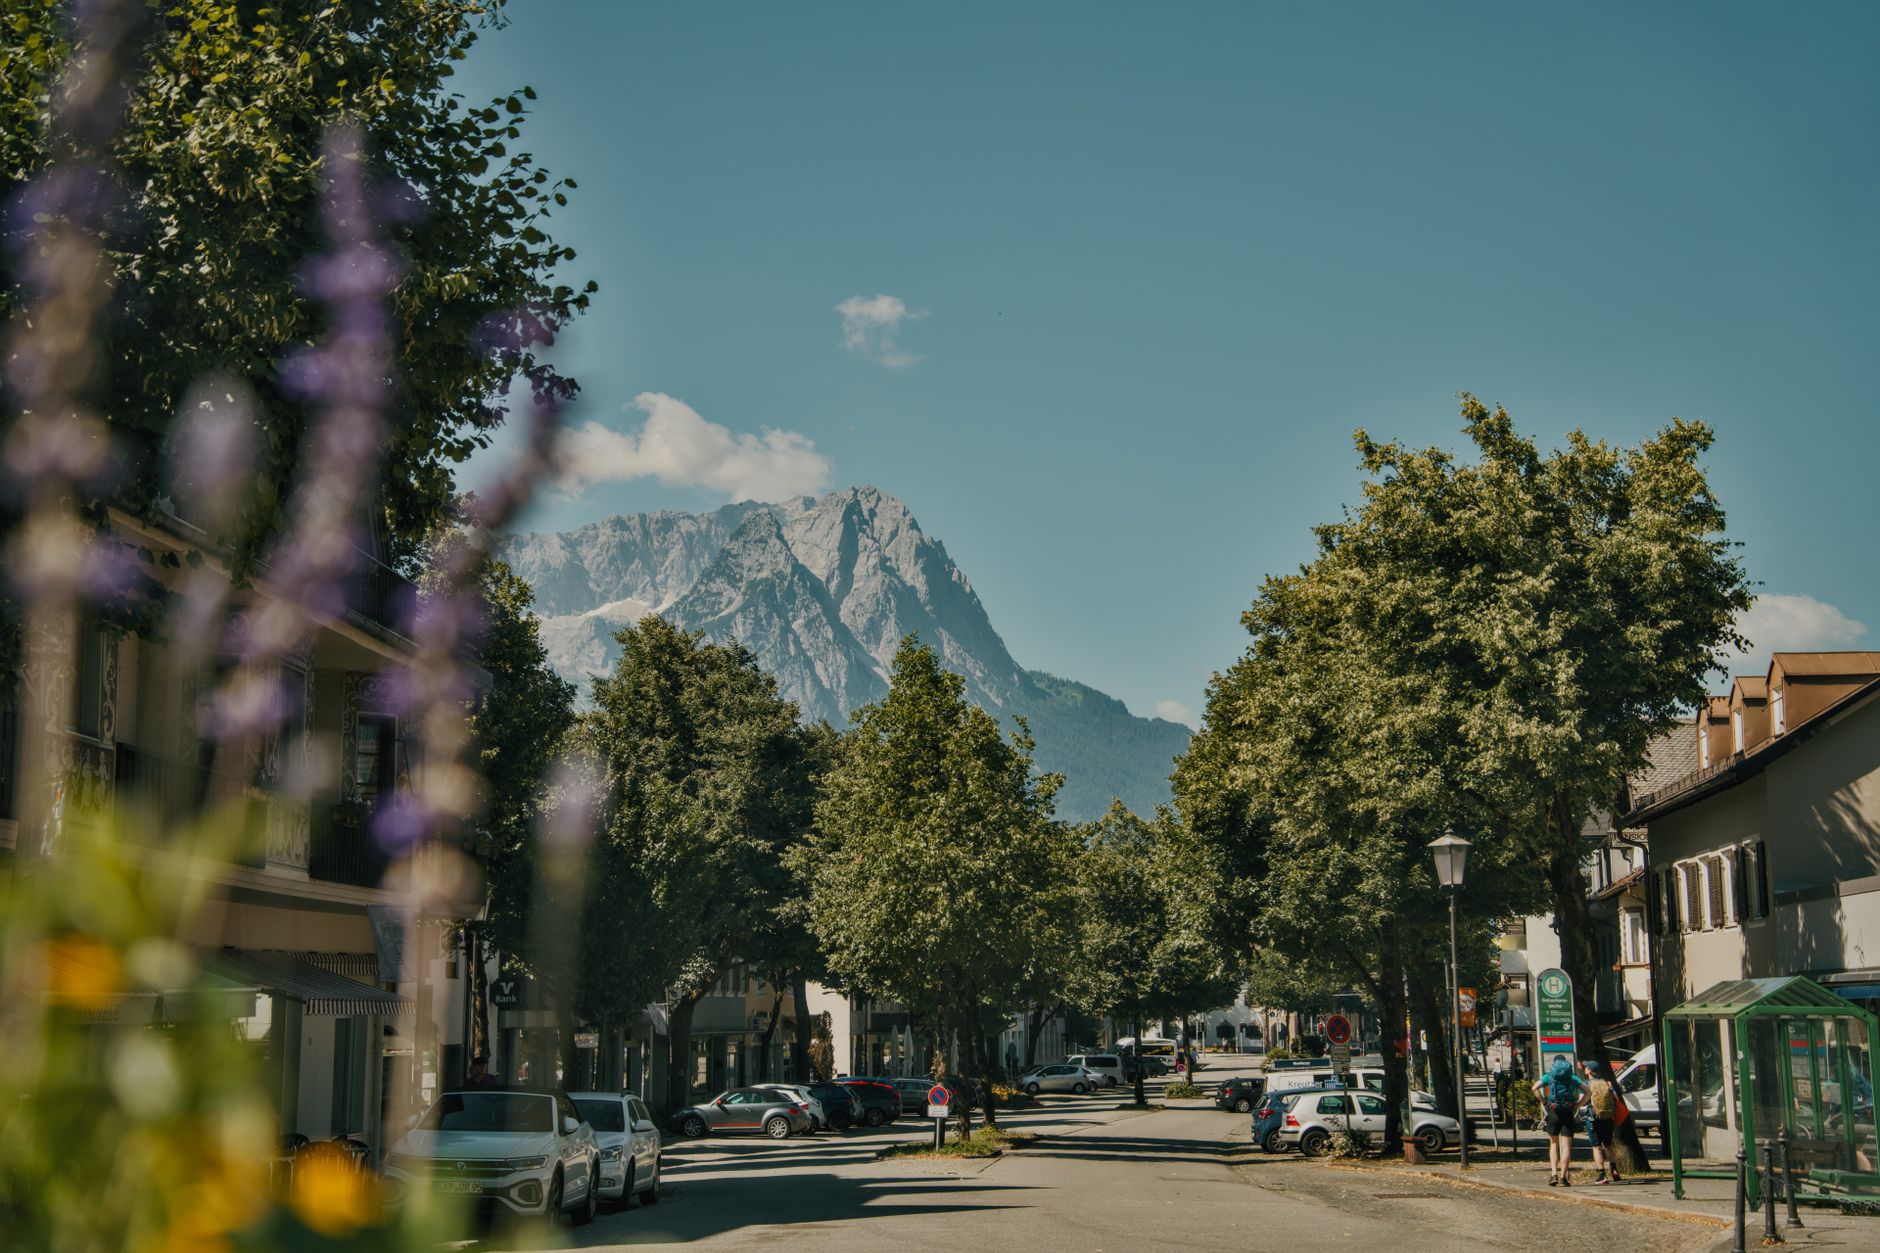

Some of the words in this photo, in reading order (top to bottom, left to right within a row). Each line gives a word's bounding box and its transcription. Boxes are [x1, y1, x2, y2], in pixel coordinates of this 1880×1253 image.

[1549, 979, 1559, 992] H
[495, 994, 517, 1003] Bank
[1288, 1080, 1323, 1088] Kreutzer
